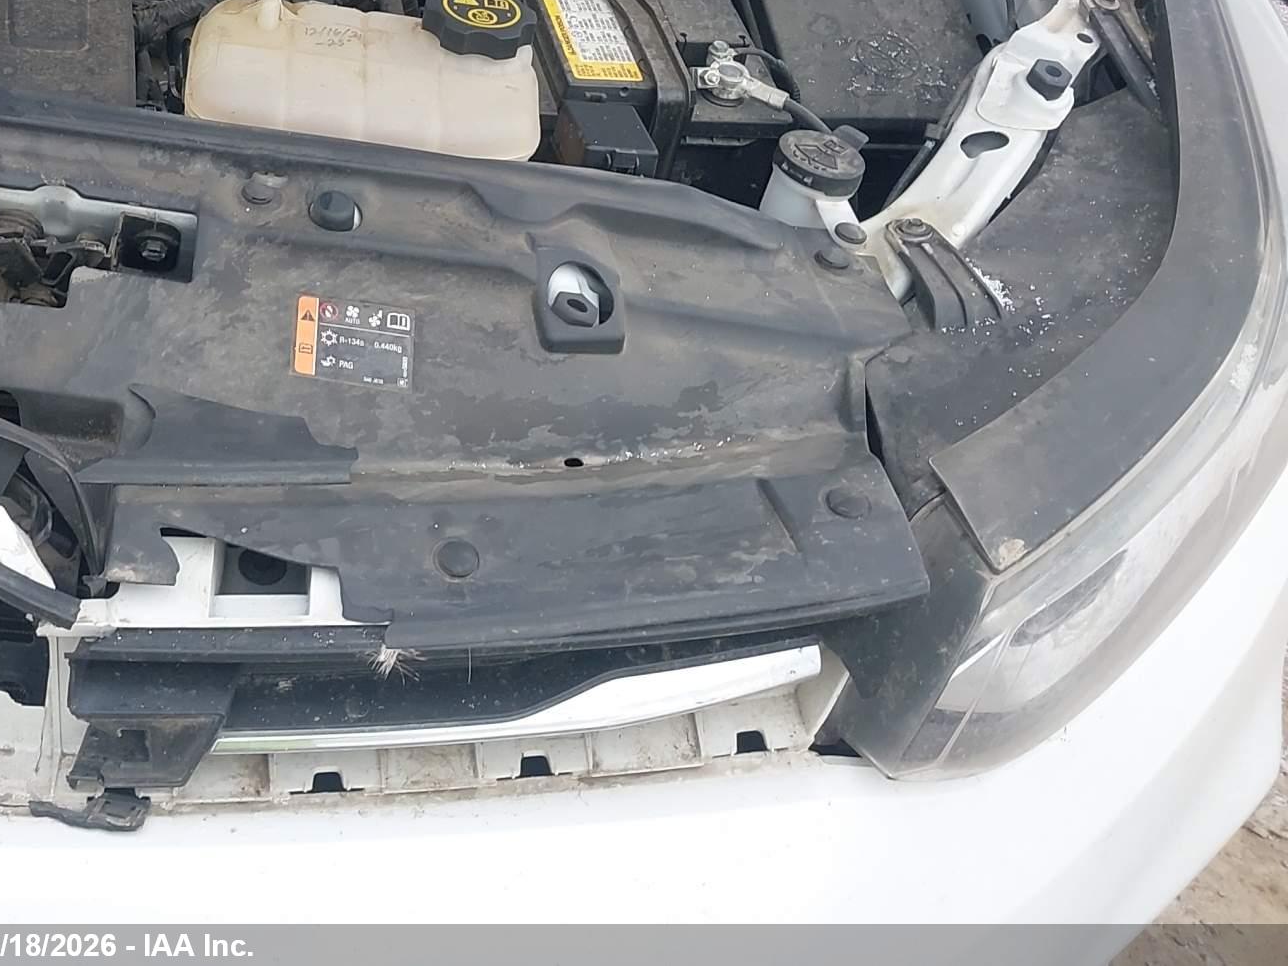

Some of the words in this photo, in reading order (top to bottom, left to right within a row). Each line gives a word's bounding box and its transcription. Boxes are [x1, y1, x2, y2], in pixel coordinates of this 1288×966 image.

[345, 317, 361, 325] AUTO
[339, 336, 365, 347] R-134a
[374, 341, 403, 354] 0.440kg
[339, 360, 354, 370] PAG
